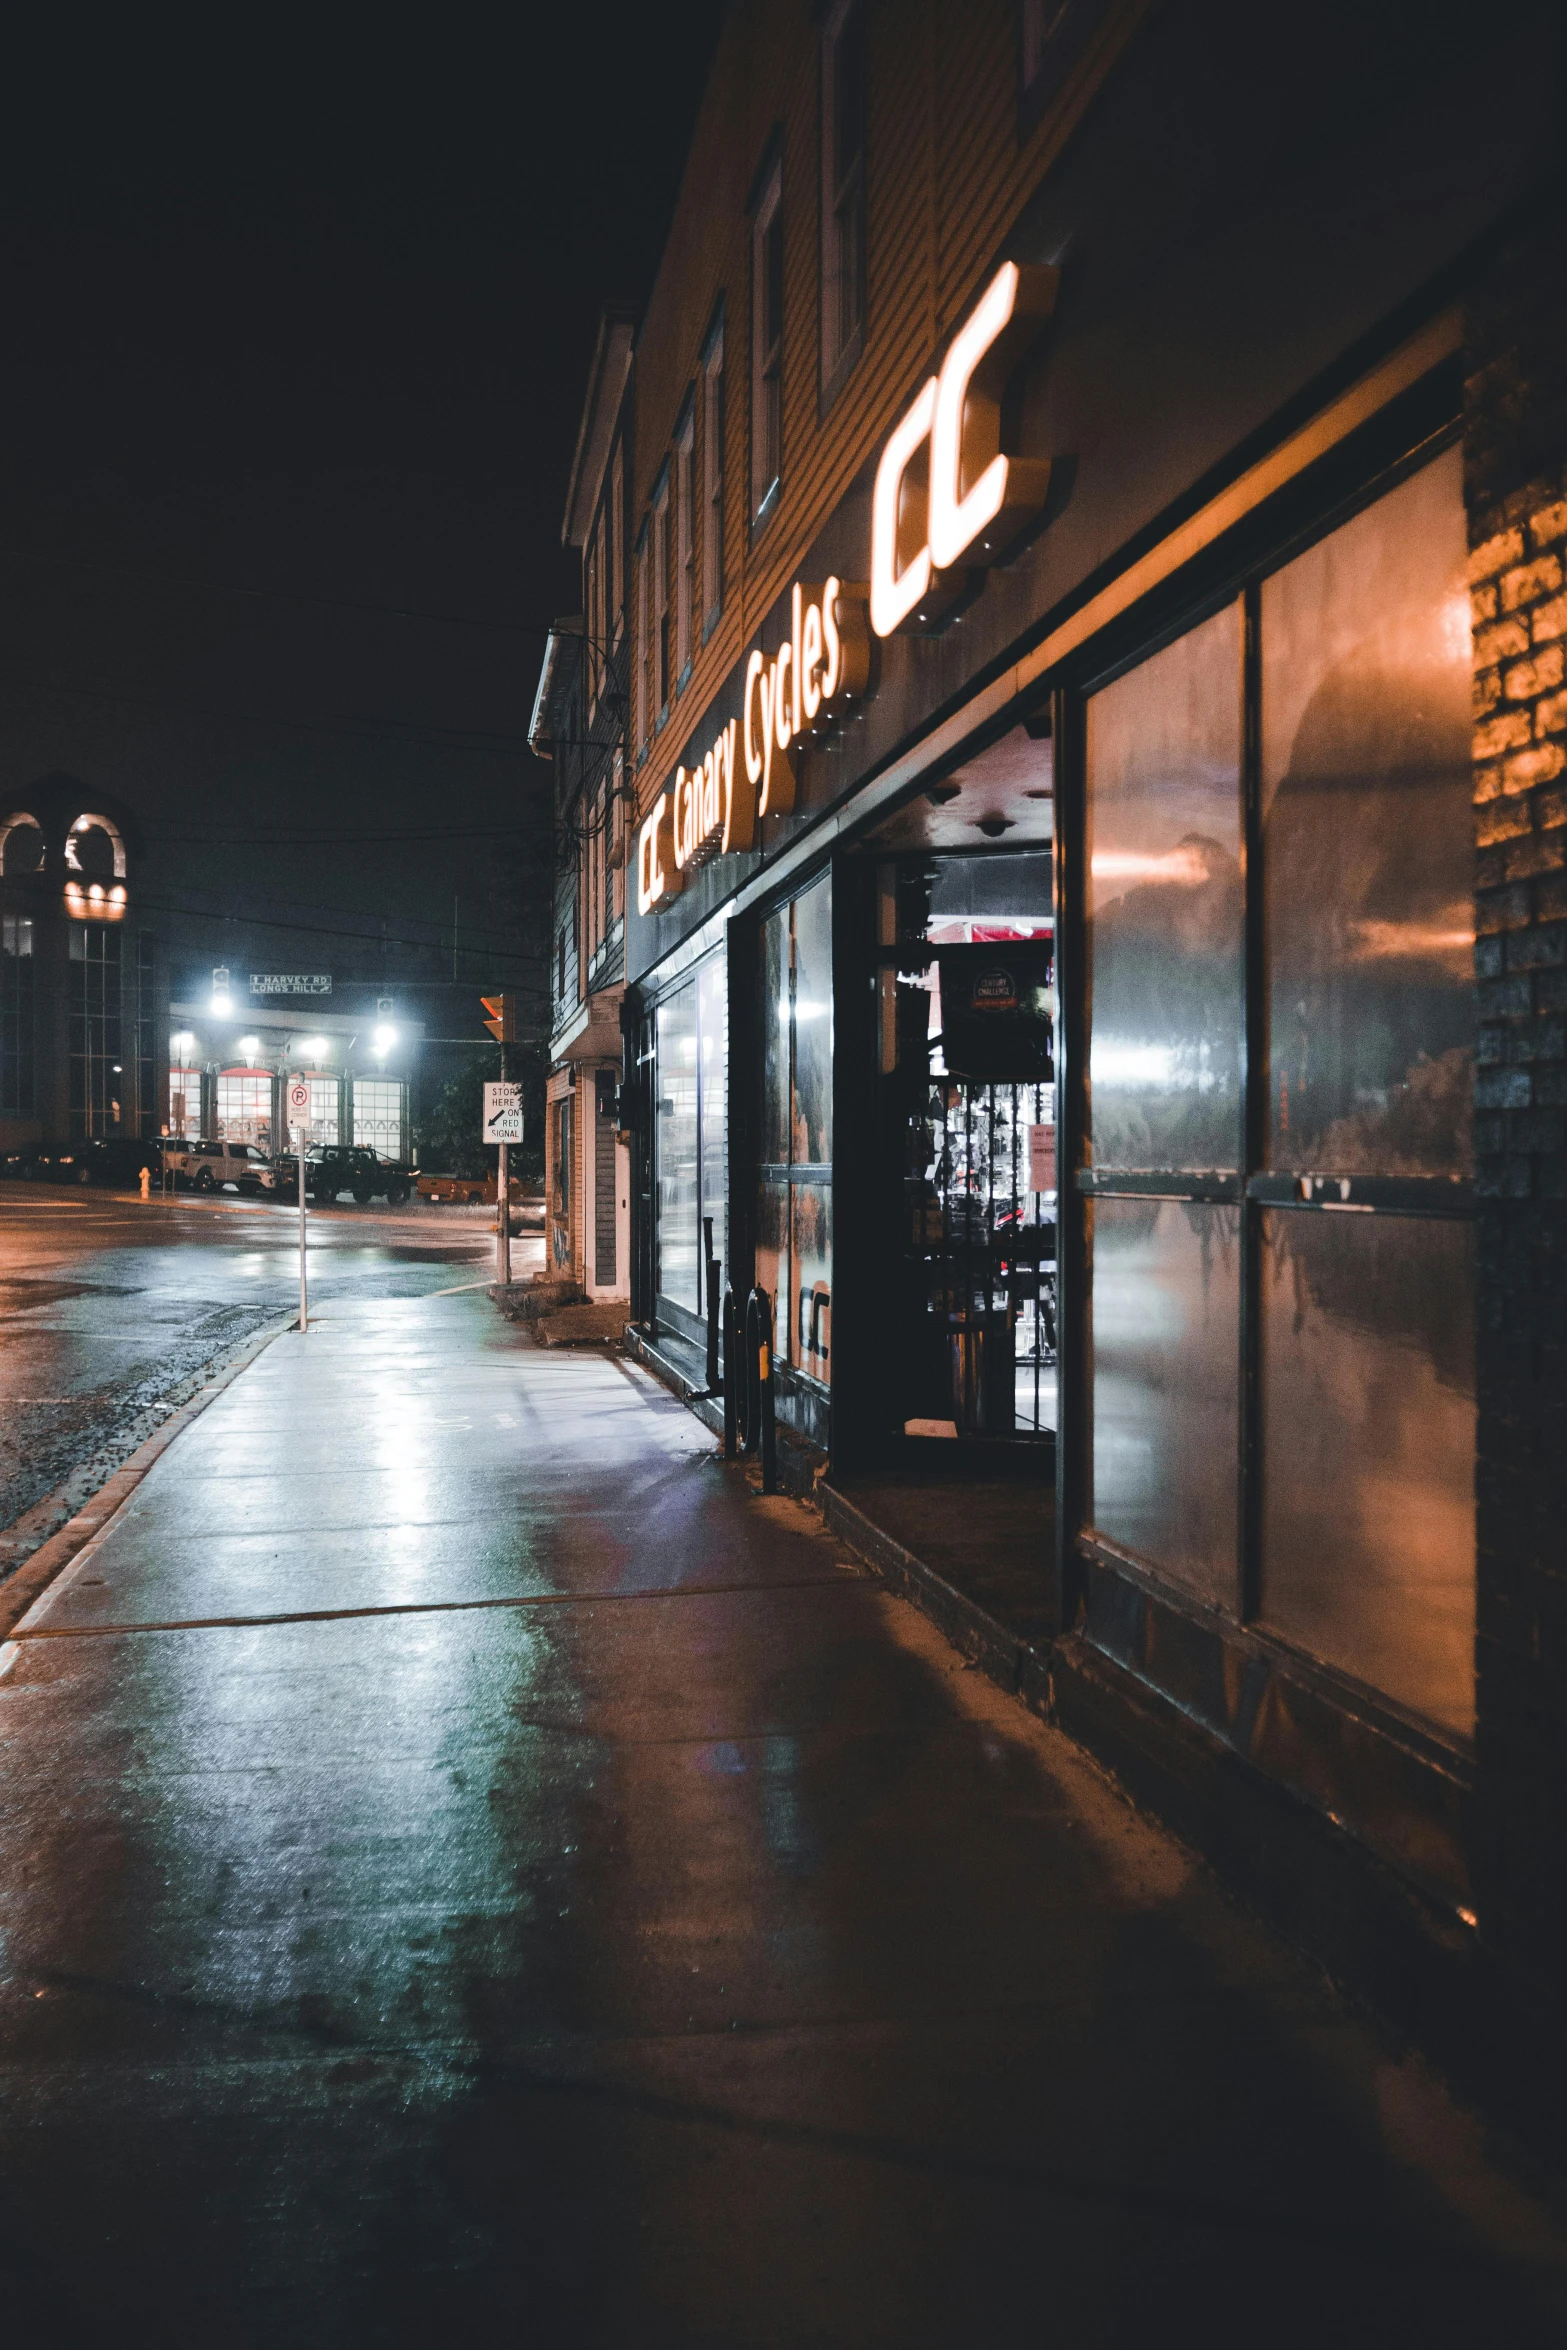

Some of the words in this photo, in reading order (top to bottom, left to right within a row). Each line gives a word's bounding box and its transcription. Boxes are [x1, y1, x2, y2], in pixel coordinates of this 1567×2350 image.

[638, 792, 666, 916] CC
[674, 718, 737, 870] Canary
[744, 576, 840, 818] Cycles
[870, 260, 1019, 637] CC
[264, 976, 308, 984] HARVEY
[313, 976, 327, 984] RD
[492, 1088, 515, 1096] STOP
[492, 1098, 515, 1106] HERE
[508, 1109, 520, 1117] ON
